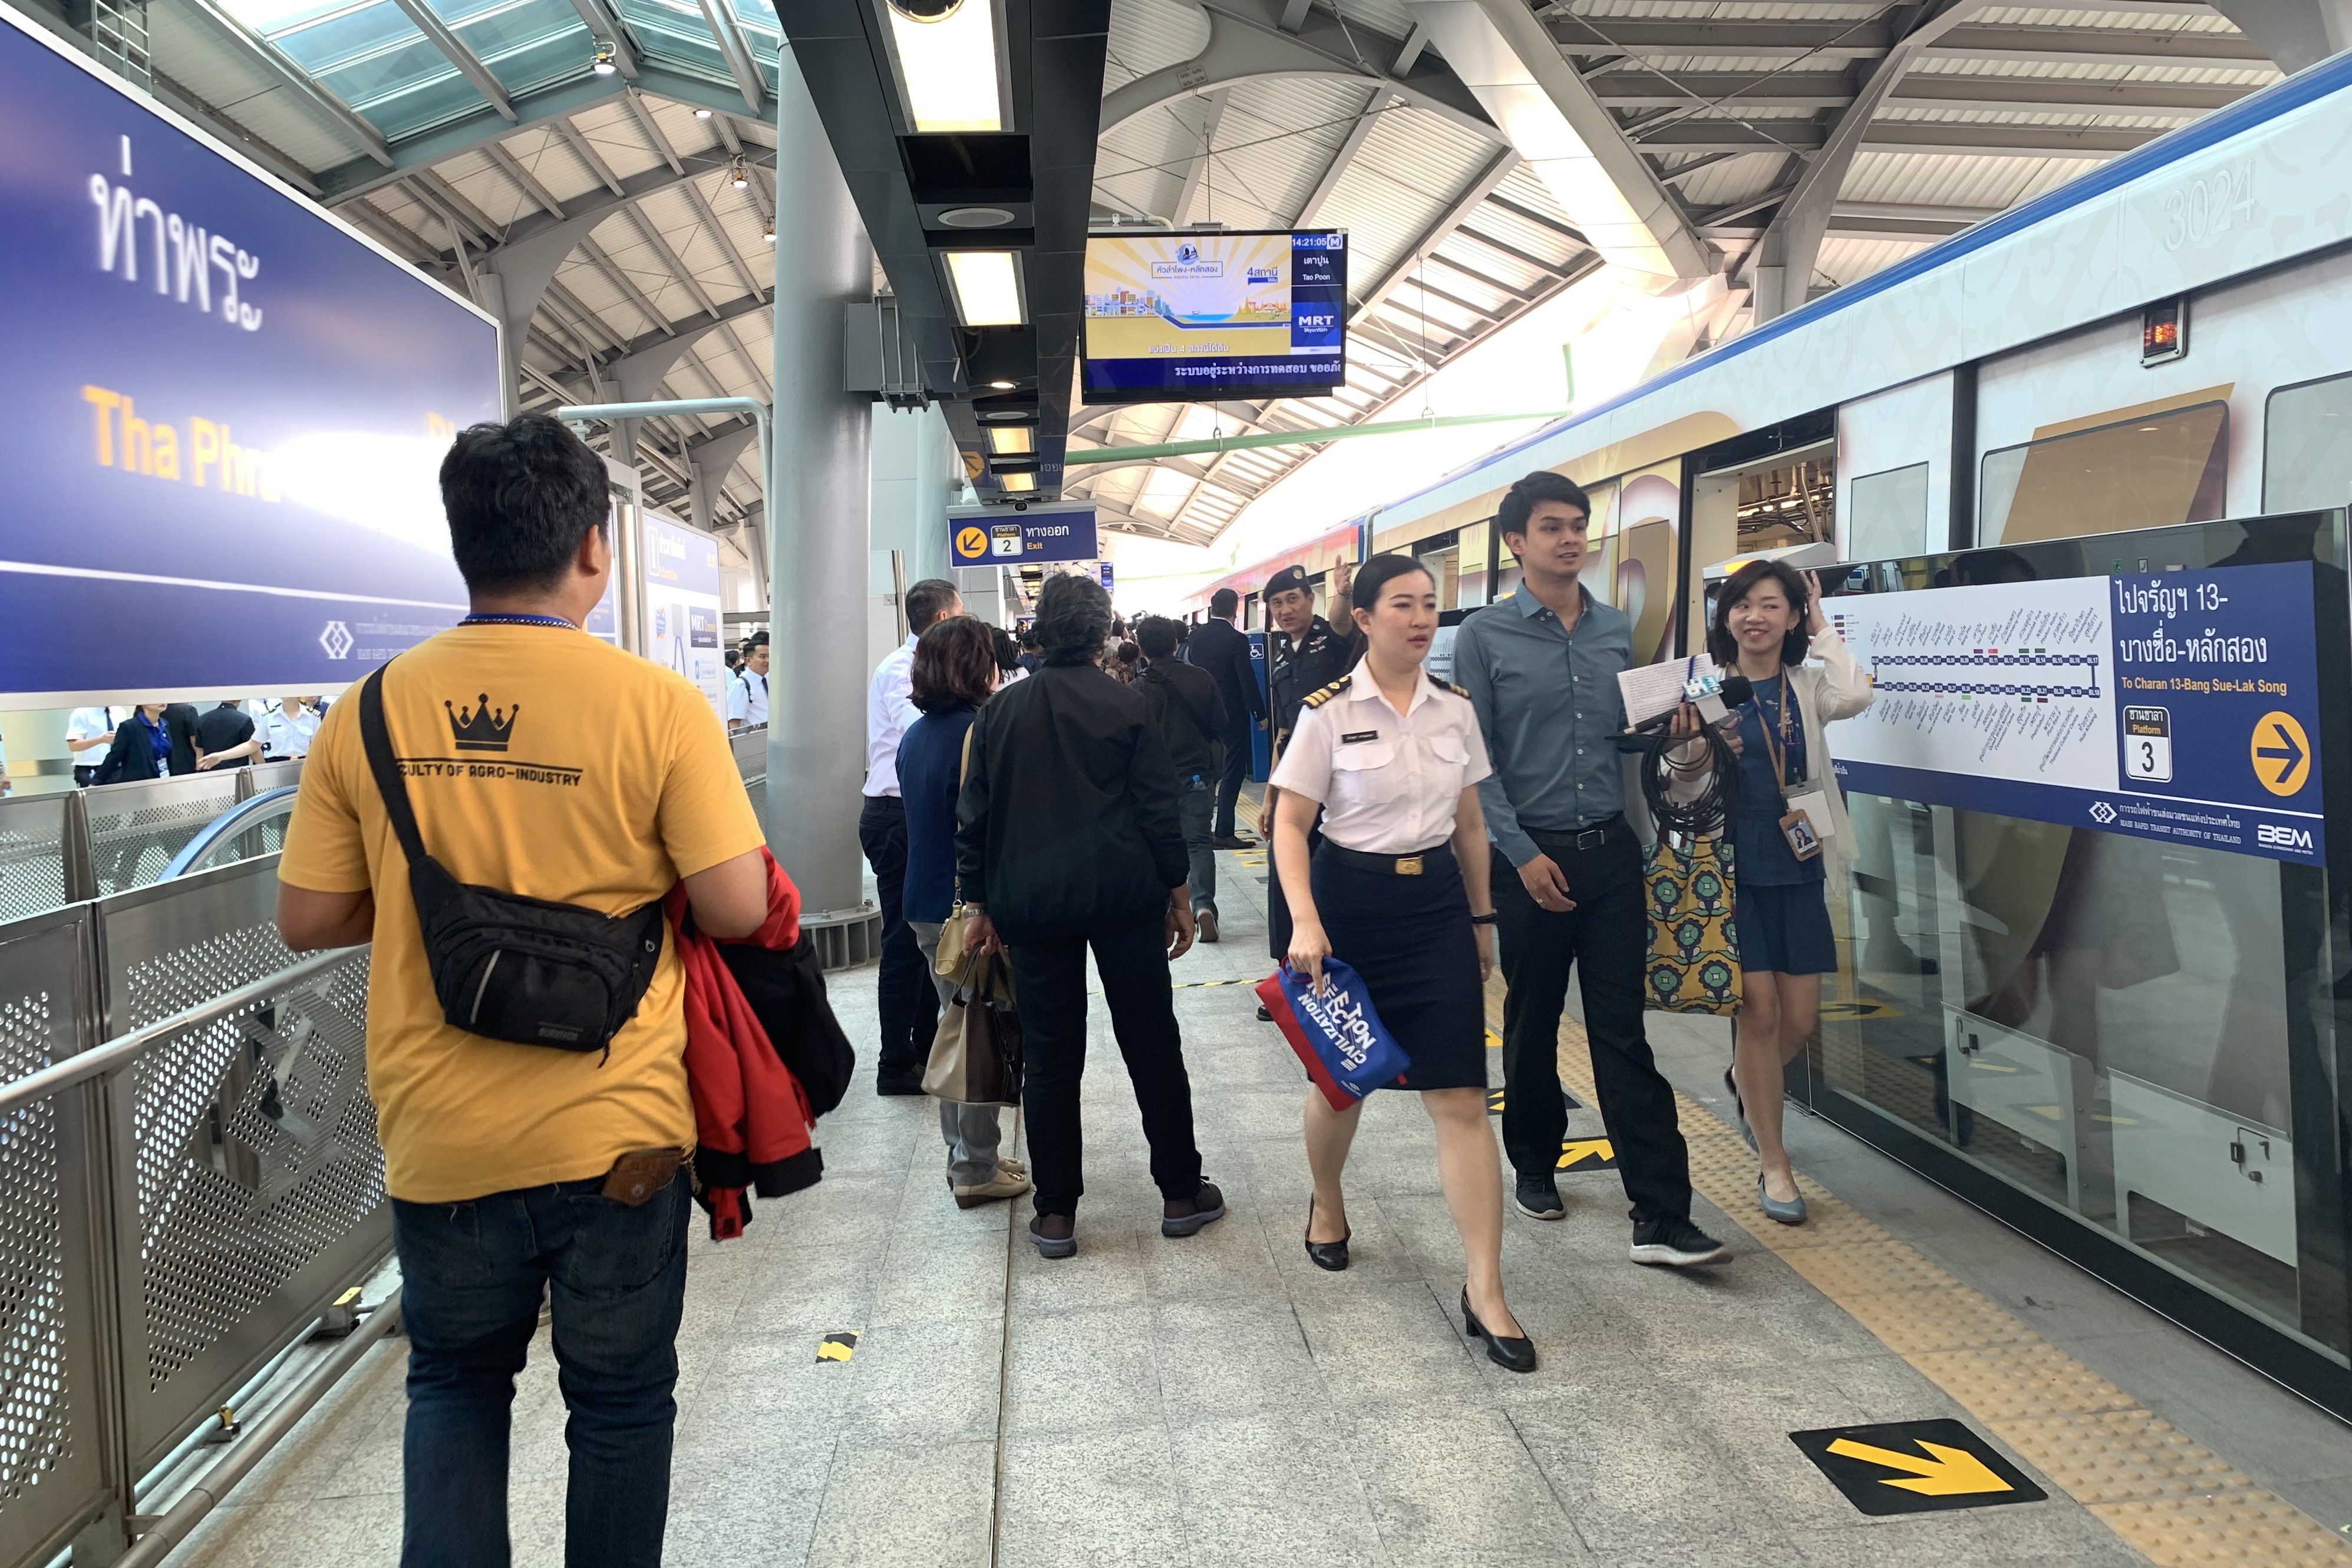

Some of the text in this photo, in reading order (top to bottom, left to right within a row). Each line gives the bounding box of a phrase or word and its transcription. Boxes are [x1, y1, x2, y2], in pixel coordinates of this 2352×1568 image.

[2165, 157, 2256, 252] 3024
[89, 134, 260, 331] ท่าพระ
[1292, 237, 1327, 246] 14:21:05
[1157, 265, 1218, 274] หัวลำโพง-หลักสอง
[1304, 255, 1329, 267] เตาปูน
[1299, 315, 1334, 326] MRT
[1175, 361, 1307, 379] ระบบอยู่ระหว่างการทดสอบ
[82, 385, 180, 480] Tha
[1026, 526, 1069, 537] ทางออก
[1003, 540, 1011, 552] 2
[2115, 580, 2228, 619] ไปจรัญฯ 13-
[691, 615, 704, 632] MRT
[2120, 620, 2268, 662] บางซื่อ-หลักสอง
[2122, 677, 2287, 696] To Charan 13-Bang Sue-Lak Song
[2129, 709, 2163, 722] ชานชาลา
[2132, 724, 2161, 735] Platform
[2141, 741, 2155, 773] 3
[398, 764, 580, 787] CULTY OF AGRO-INDUSTRY
[2120, 819, 2133, 828] MASS
[2135, 821, 2149, 830] RAPID
[2150, 823, 2170, 834] TRANSIT
[2172, 827, 2202, 837] AUTHORITY
[2213, 833, 2242, 844] THAILAND
[2258, 824, 2313, 849] BEM
[1297, 993, 1367, 1064] CIVILIZATION
